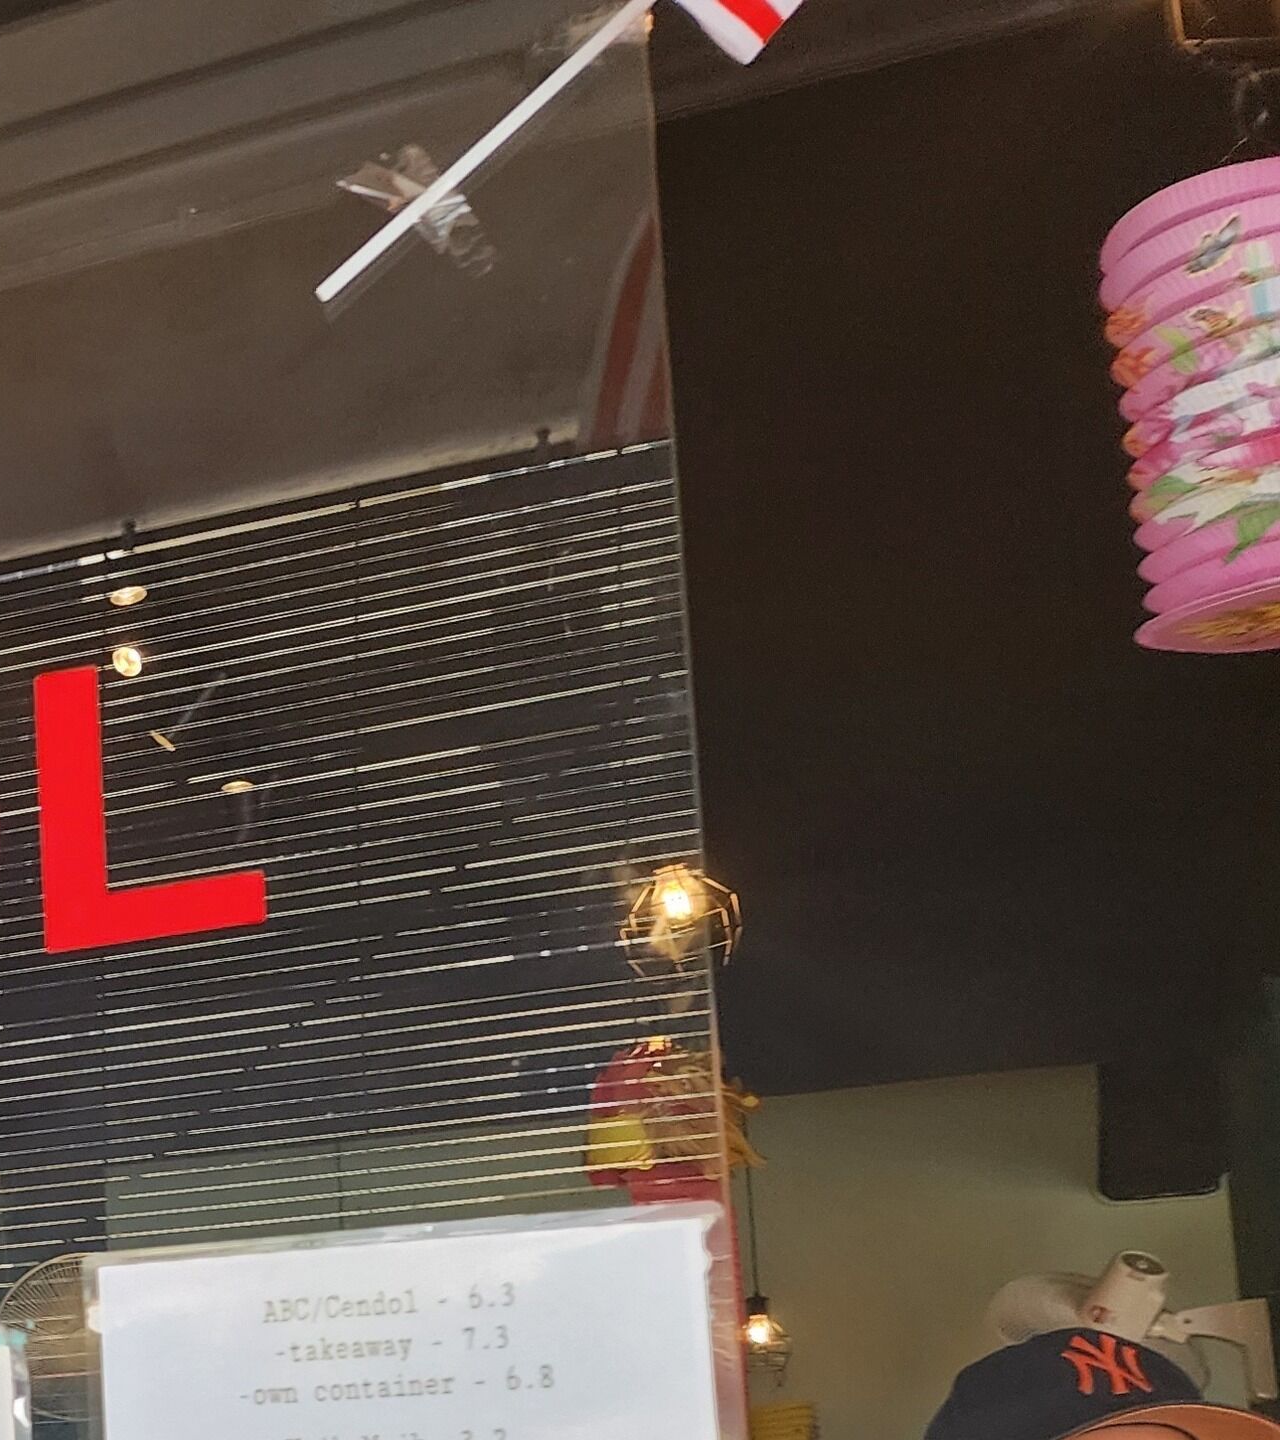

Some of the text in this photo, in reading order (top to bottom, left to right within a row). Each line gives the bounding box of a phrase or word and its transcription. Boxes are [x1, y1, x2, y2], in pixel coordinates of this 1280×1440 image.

[262, 1289, 419, 1325] ABC/Cendol
[469, 1282, 516, 1310] 6.3
[462, 1324, 510, 1351] 7.3
[313, 1373, 456, 1404] container
[505, 1363, 555, 1392] 6.8
